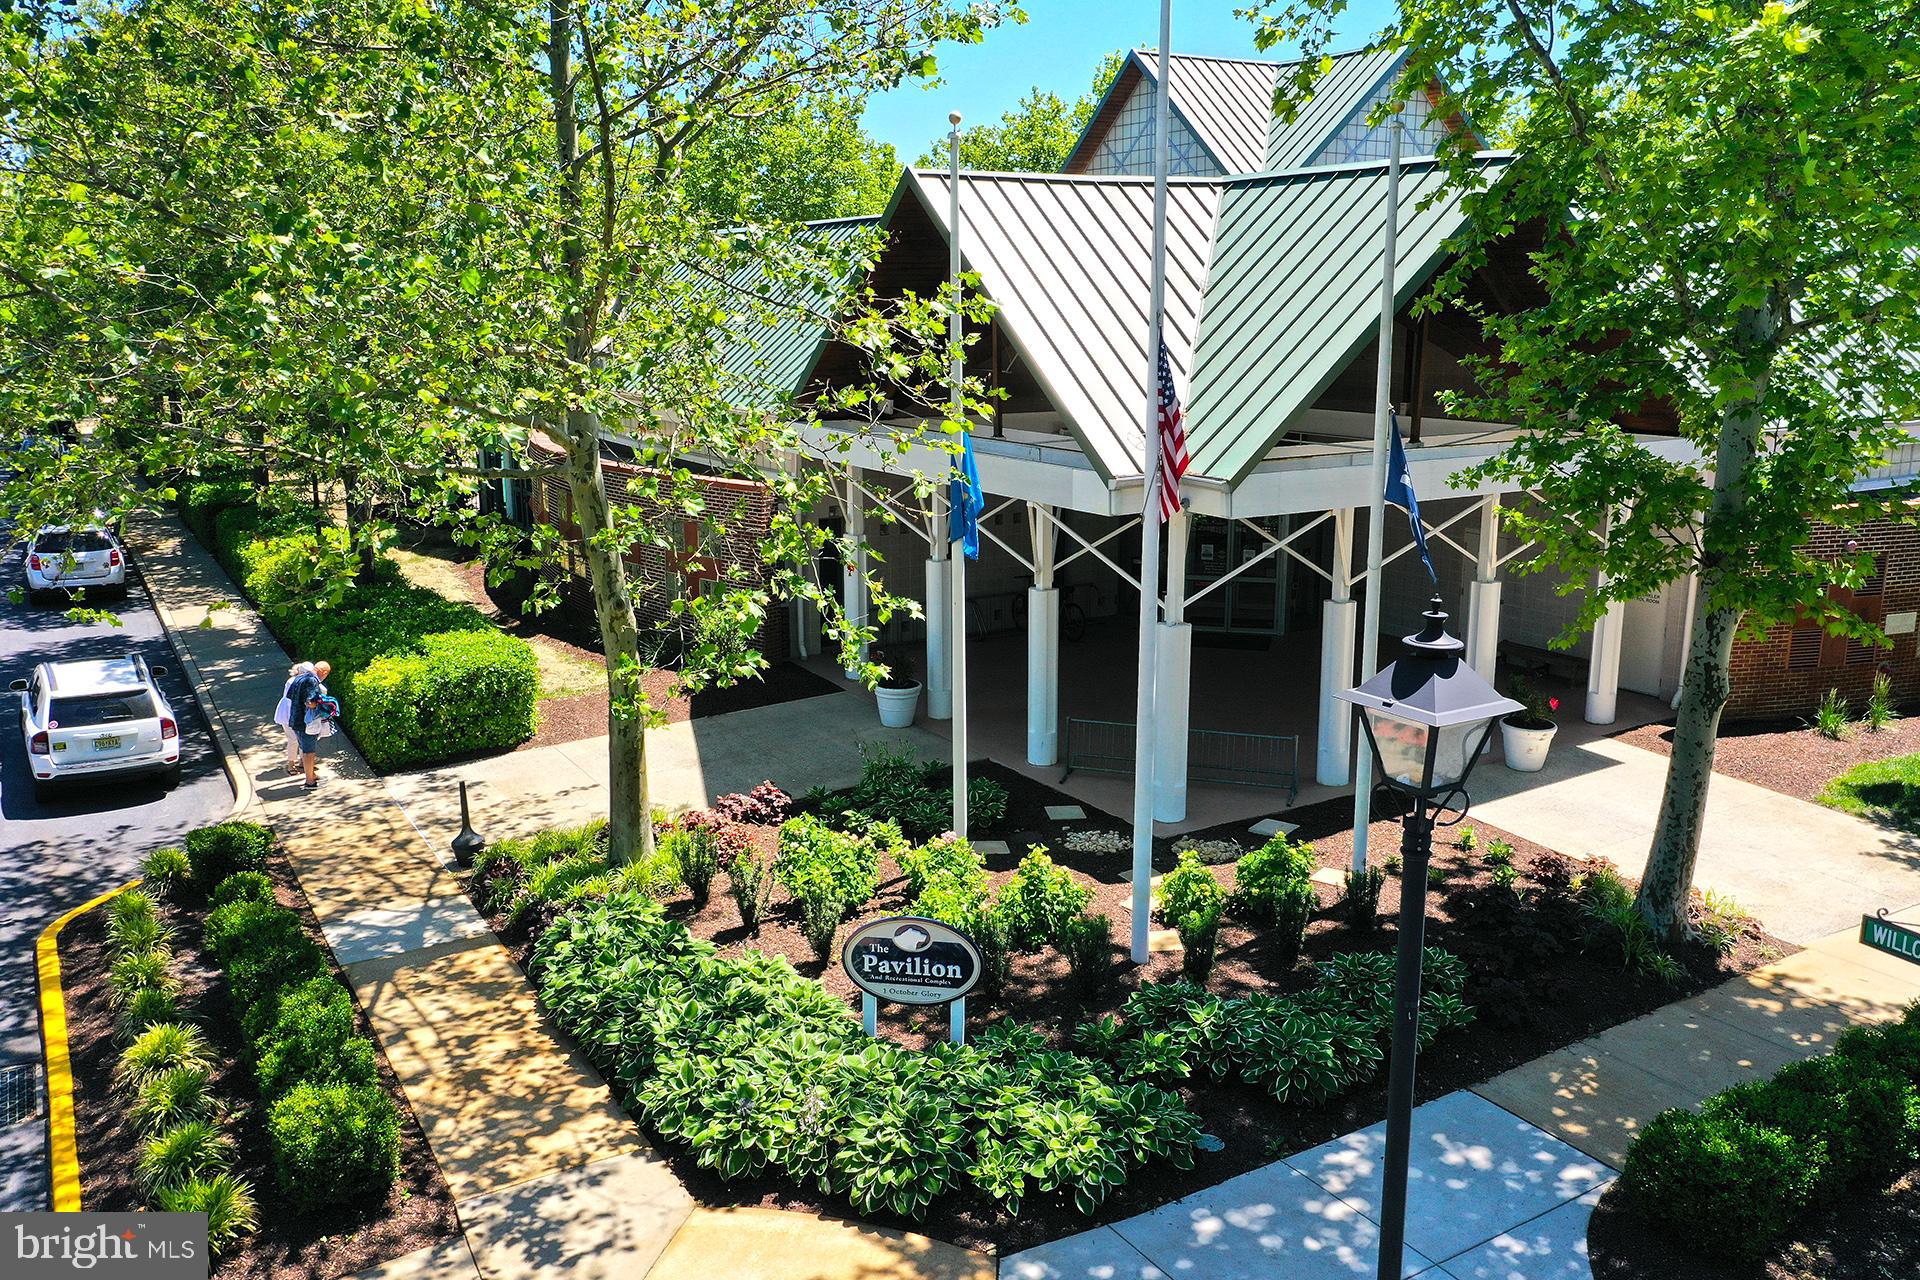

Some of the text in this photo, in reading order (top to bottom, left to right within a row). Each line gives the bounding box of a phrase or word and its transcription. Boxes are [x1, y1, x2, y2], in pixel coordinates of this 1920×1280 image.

[869, 943, 889, 953] The
[862, 954, 962, 979] Pavilion
[885, 975, 923, 983] Recreational
[924, 977, 951, 985] Complex
[889, 988, 918, 996] October
[921, 990, 942, 999] Glory
